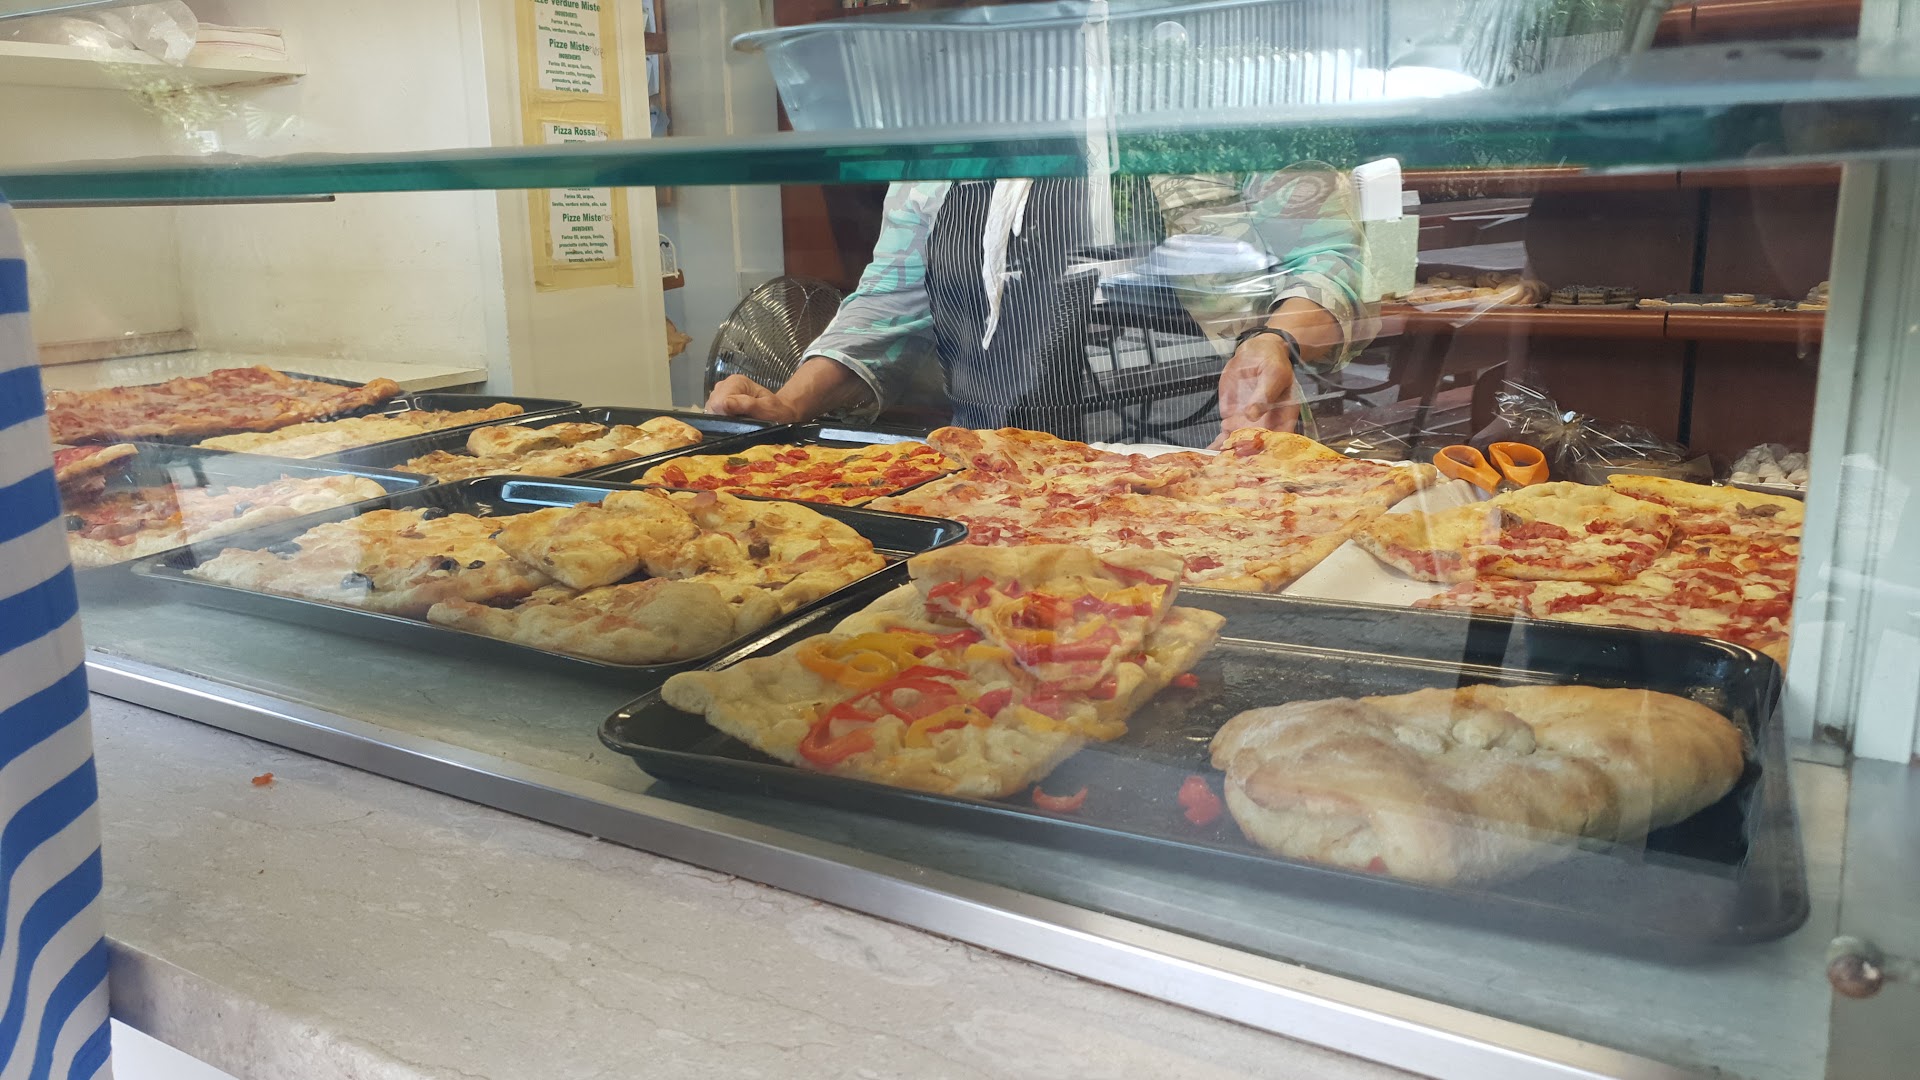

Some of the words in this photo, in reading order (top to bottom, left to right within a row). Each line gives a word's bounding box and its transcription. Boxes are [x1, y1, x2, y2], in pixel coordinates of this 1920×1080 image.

[552, 0, 579, 8] Verdure
[581, 1, 601, 12] Miste
[549, 38, 568, 49] Pizze
[570, 41, 589, 52] Miste
[554, 125, 572, 135] Pizza
[574, 127, 595, 136] Rossa
[563, 214, 580, 222] Pizze
[583, 214, 601, 222] Miste
